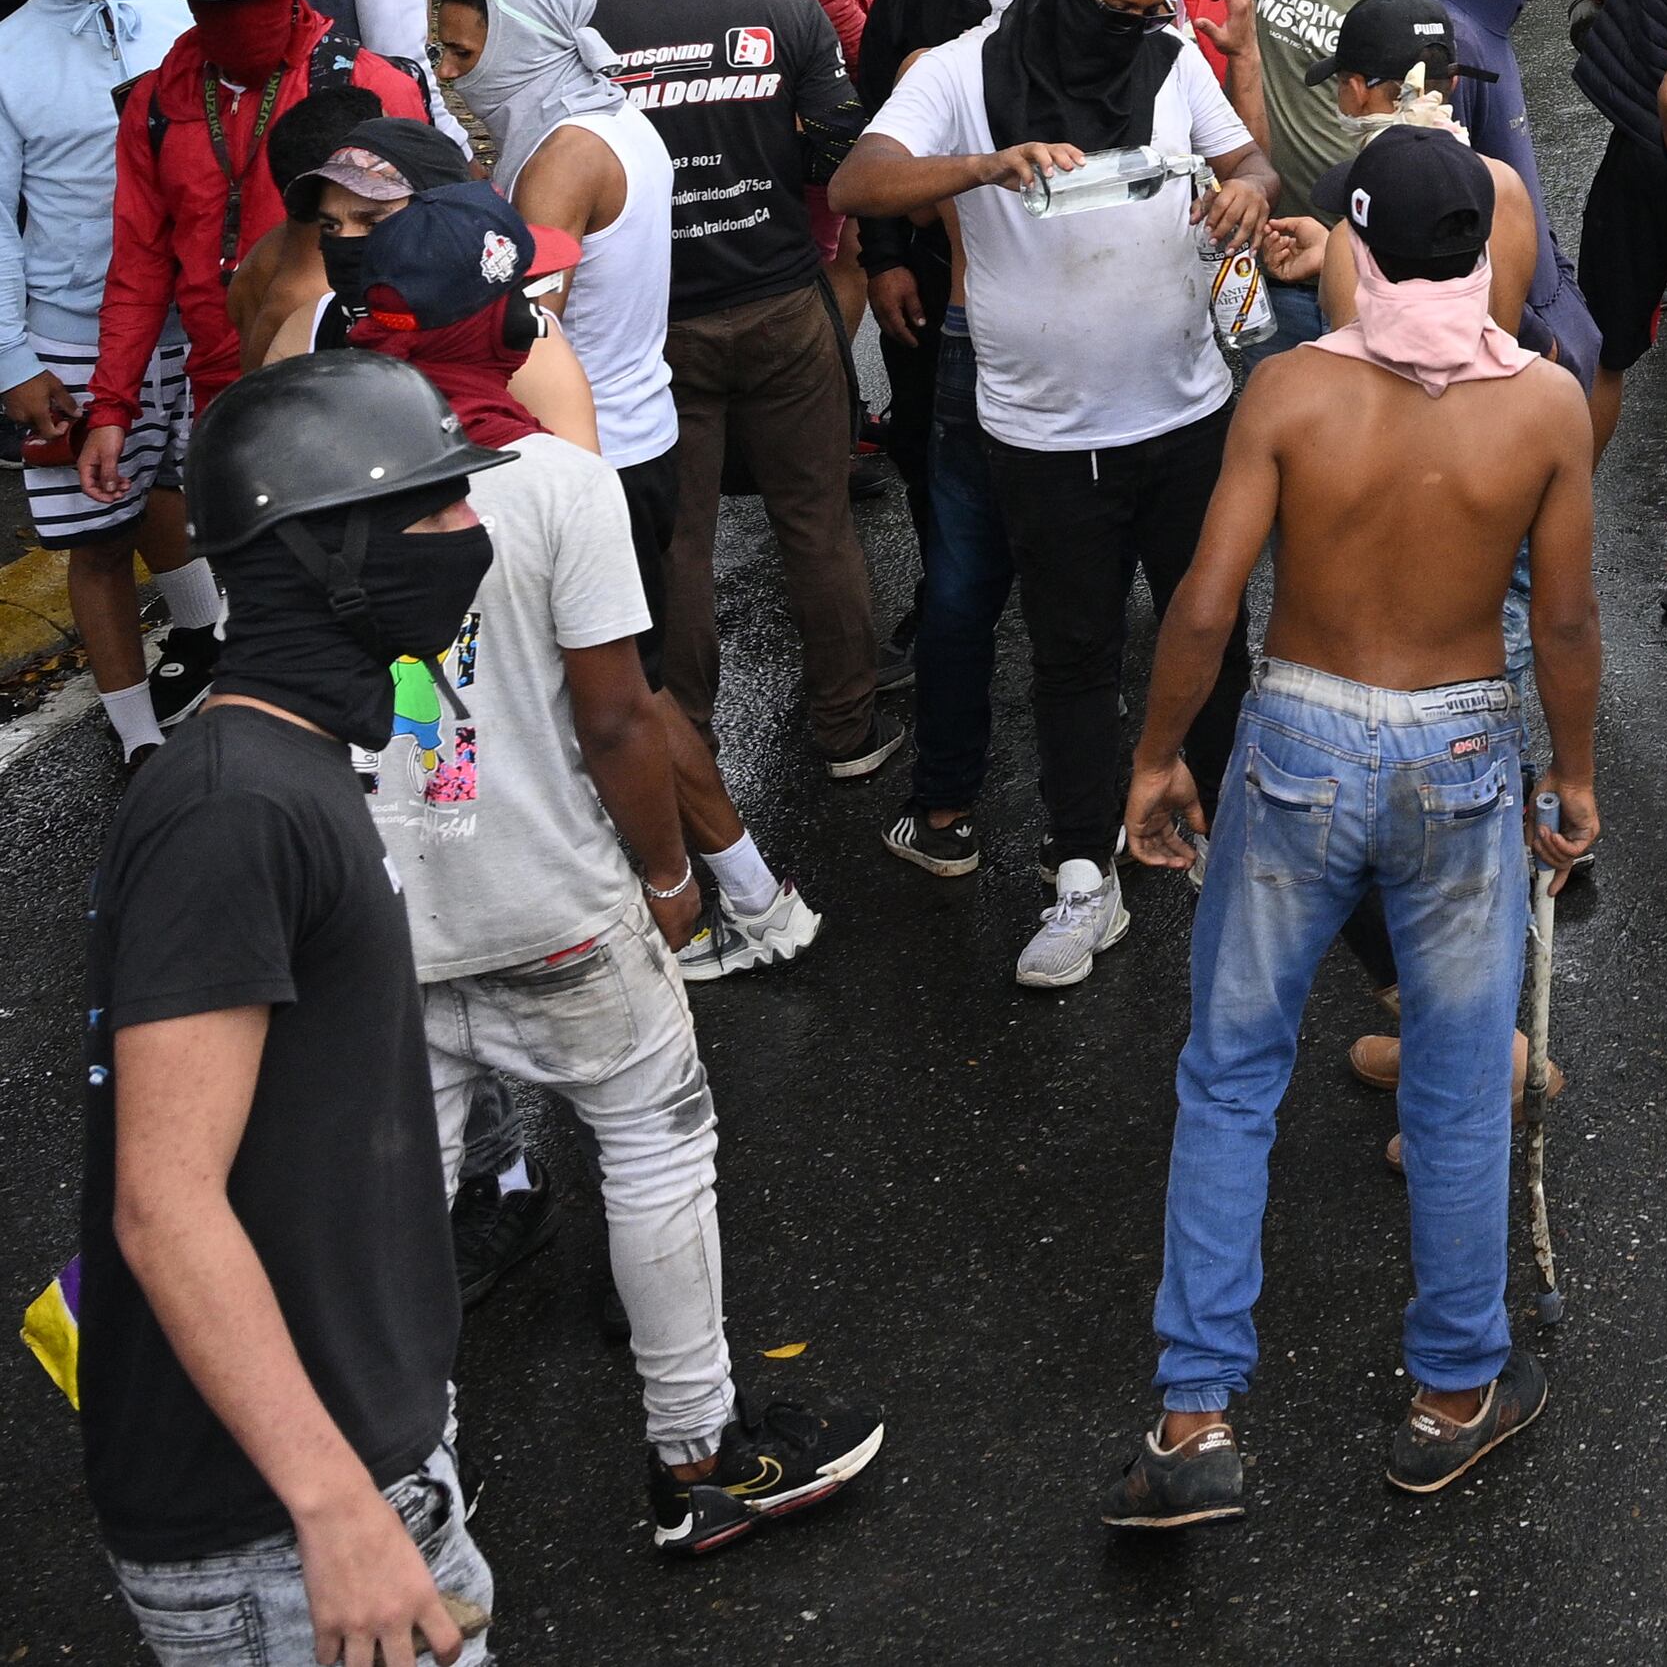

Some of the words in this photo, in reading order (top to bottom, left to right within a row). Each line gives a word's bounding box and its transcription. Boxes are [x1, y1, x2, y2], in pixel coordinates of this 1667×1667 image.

[617, 43, 714, 69] TOSONIDO
[626, 73, 782, 111] ALDOMAR
[204, 79, 223, 142] SUZUKI
[254, 72, 281, 138] SUZUKI
[672, 156, 689, 170] 93
[691, 153, 723, 167] 8017
[671, 224, 704, 240] onido
[1410, 1419, 1441, 1437] balance
[1419, 1414, 1436, 1425] new
[1207, 1431, 1225, 1441] new
[1199, 1439, 1232, 1452] balance
